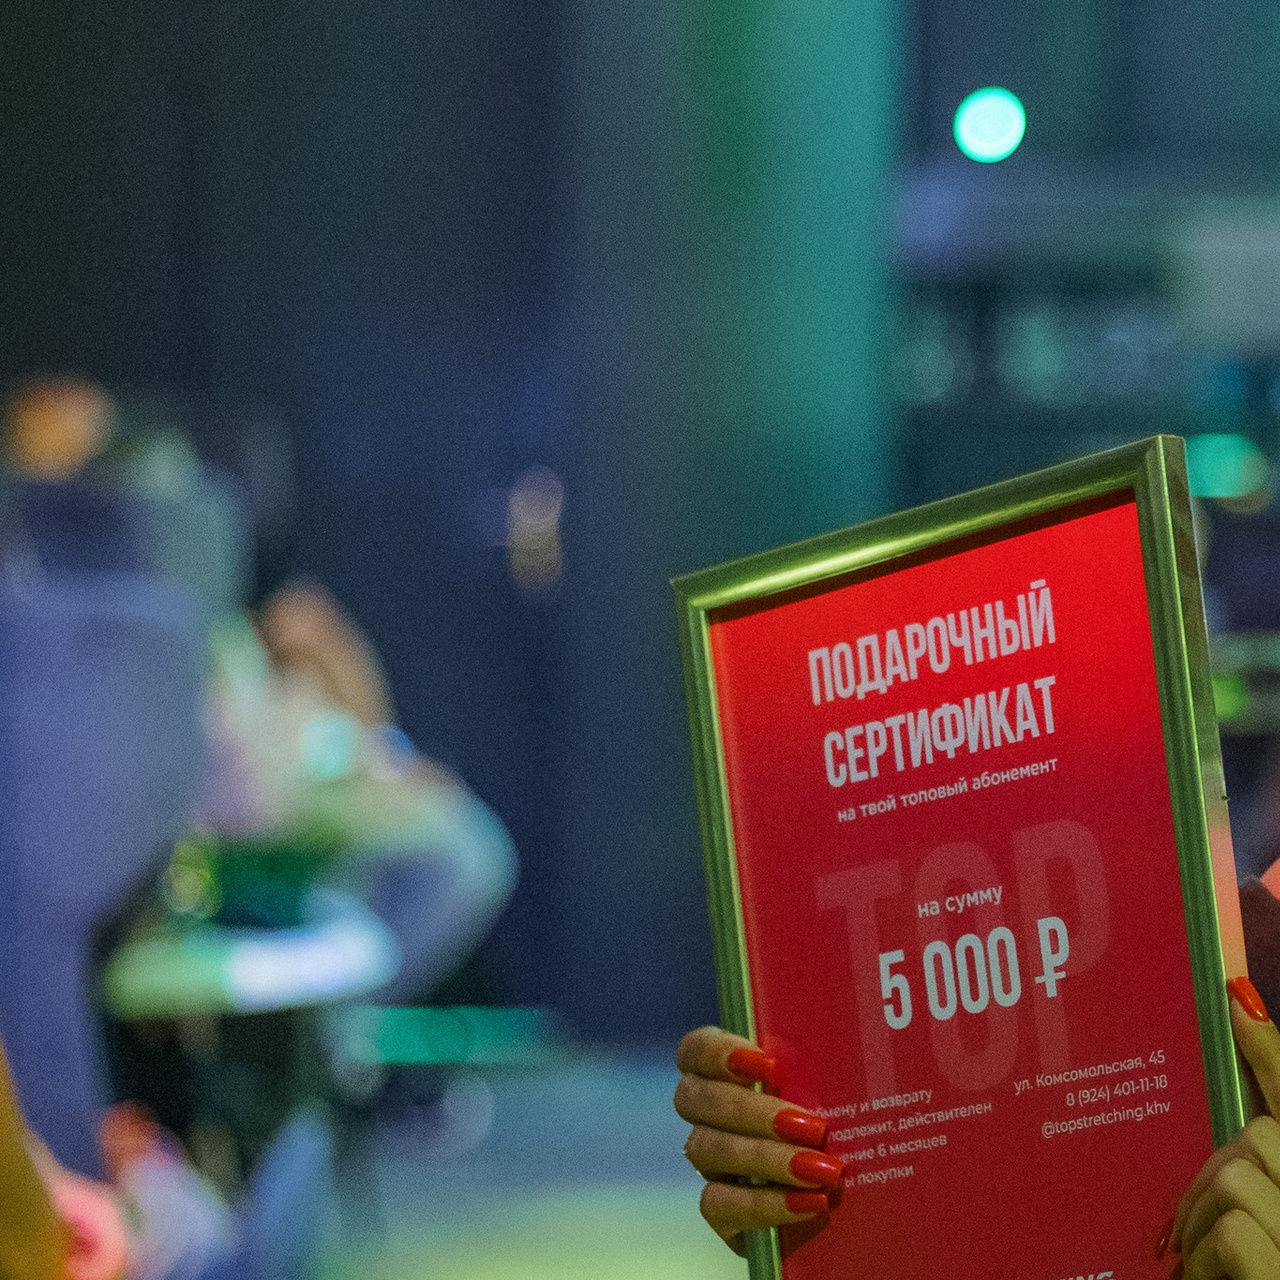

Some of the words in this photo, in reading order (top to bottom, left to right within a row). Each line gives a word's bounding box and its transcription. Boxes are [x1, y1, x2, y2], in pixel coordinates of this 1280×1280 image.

[808, 579, 1056, 706] ПОДАРОЧНЫЙ
[823, 675, 1056, 788] СЕРТИФИКАТ
[837, 808, 856, 823] на
[859, 794, 896, 818] твой
[900, 777, 968, 807] топовый
[972, 758, 1058, 791] абонемент
[917, 897, 940, 919] на
[945, 885, 1003, 913] сумму
[878, 949, 913, 1030] 5
[922, 926, 1022, 1021] 000
[1013, 1079, 1033, 1096] ул.
[1036, 1056, 1146, 1089] Комсомольская,
[1148, 1049, 1166, 1065] 45
[860, 1102, 869, 1113] и
[871, 1089, 933, 1112] возврату
[1065, 1091, 1075, 1107] 8
[1078, 1084, 1110, 1108] (924)
[1113, 1074, 1168, 1098] 401-11-18
[899, 1102, 992, 1131] действителен
[1041, 1100, 1171, 1139] @topstretching.khv
[877, 1143, 886, 1157] 6
[889, 1134, 948, 1155] месяцев
[857, 1165, 914, 1186] покупки
